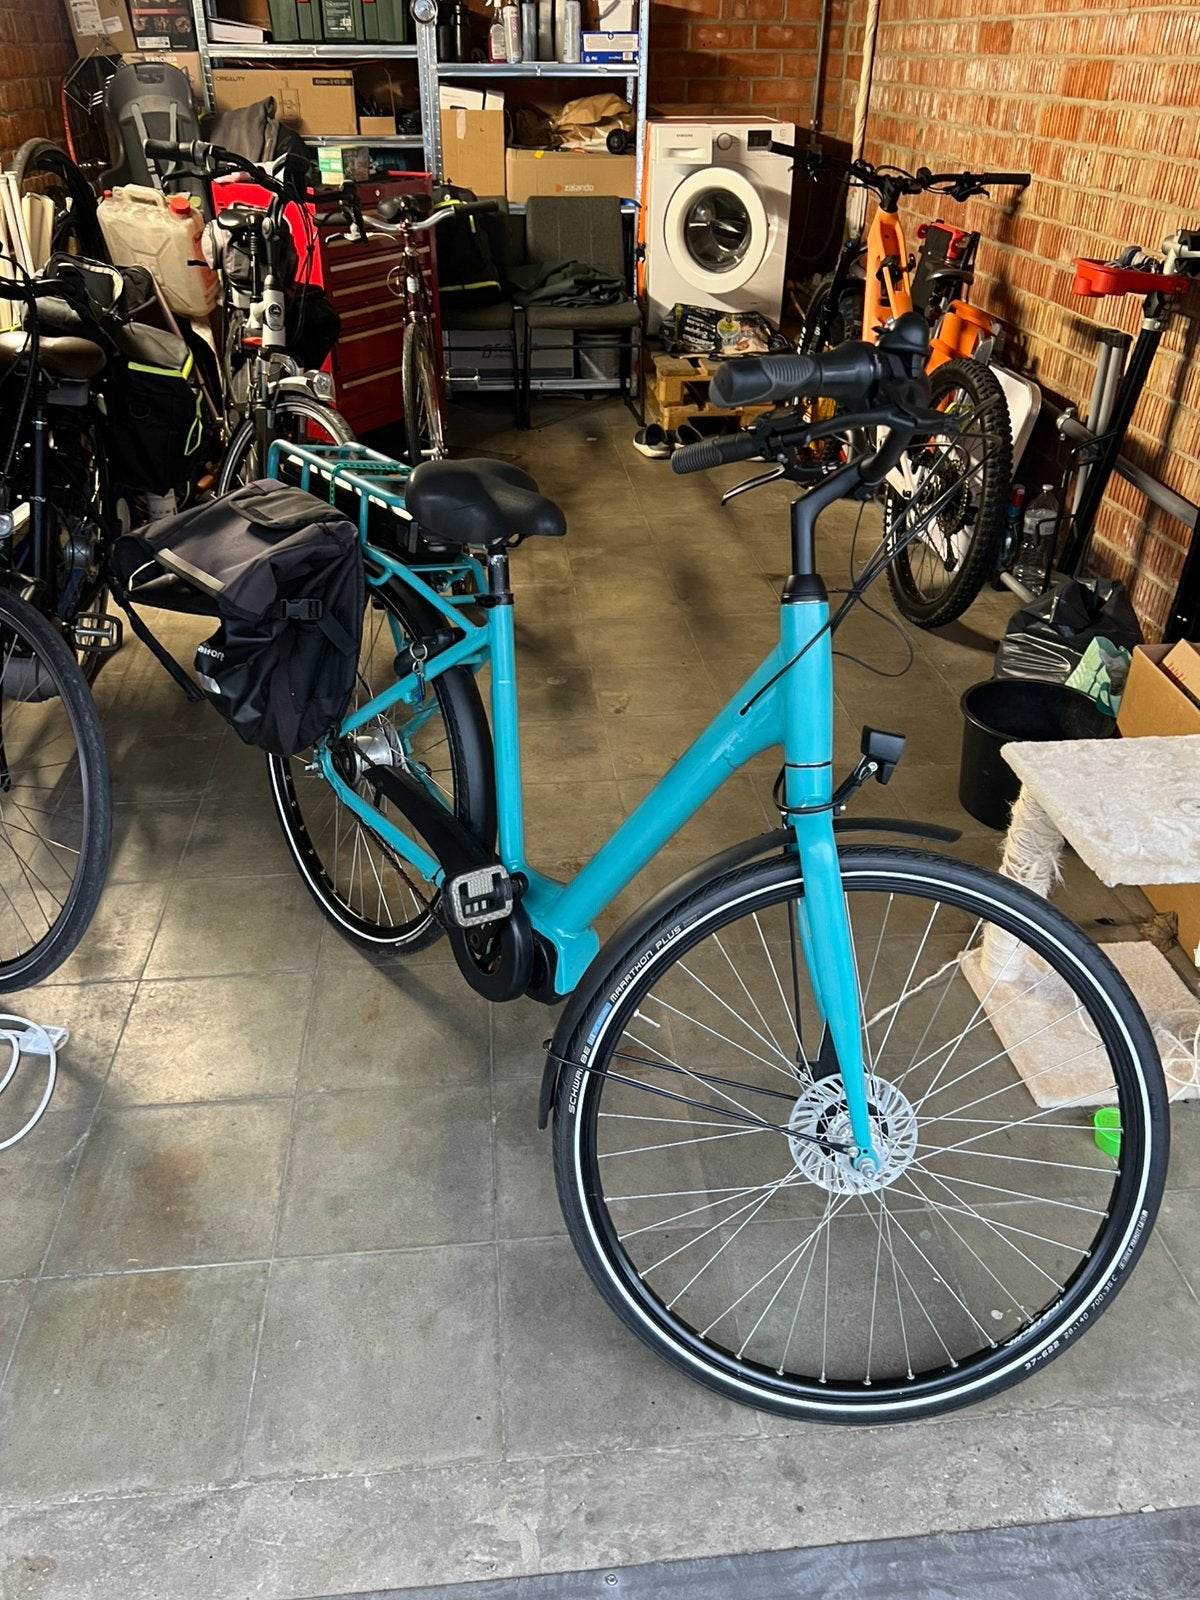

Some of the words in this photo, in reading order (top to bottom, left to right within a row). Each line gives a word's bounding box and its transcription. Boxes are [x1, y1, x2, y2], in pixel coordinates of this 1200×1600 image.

[564, 183, 595, 192] zalando
[609, 950, 654, 1004] MARATHON
[655, 925, 682, 951] PLUS
[1024, 1339, 1061, 1371] 37-622
